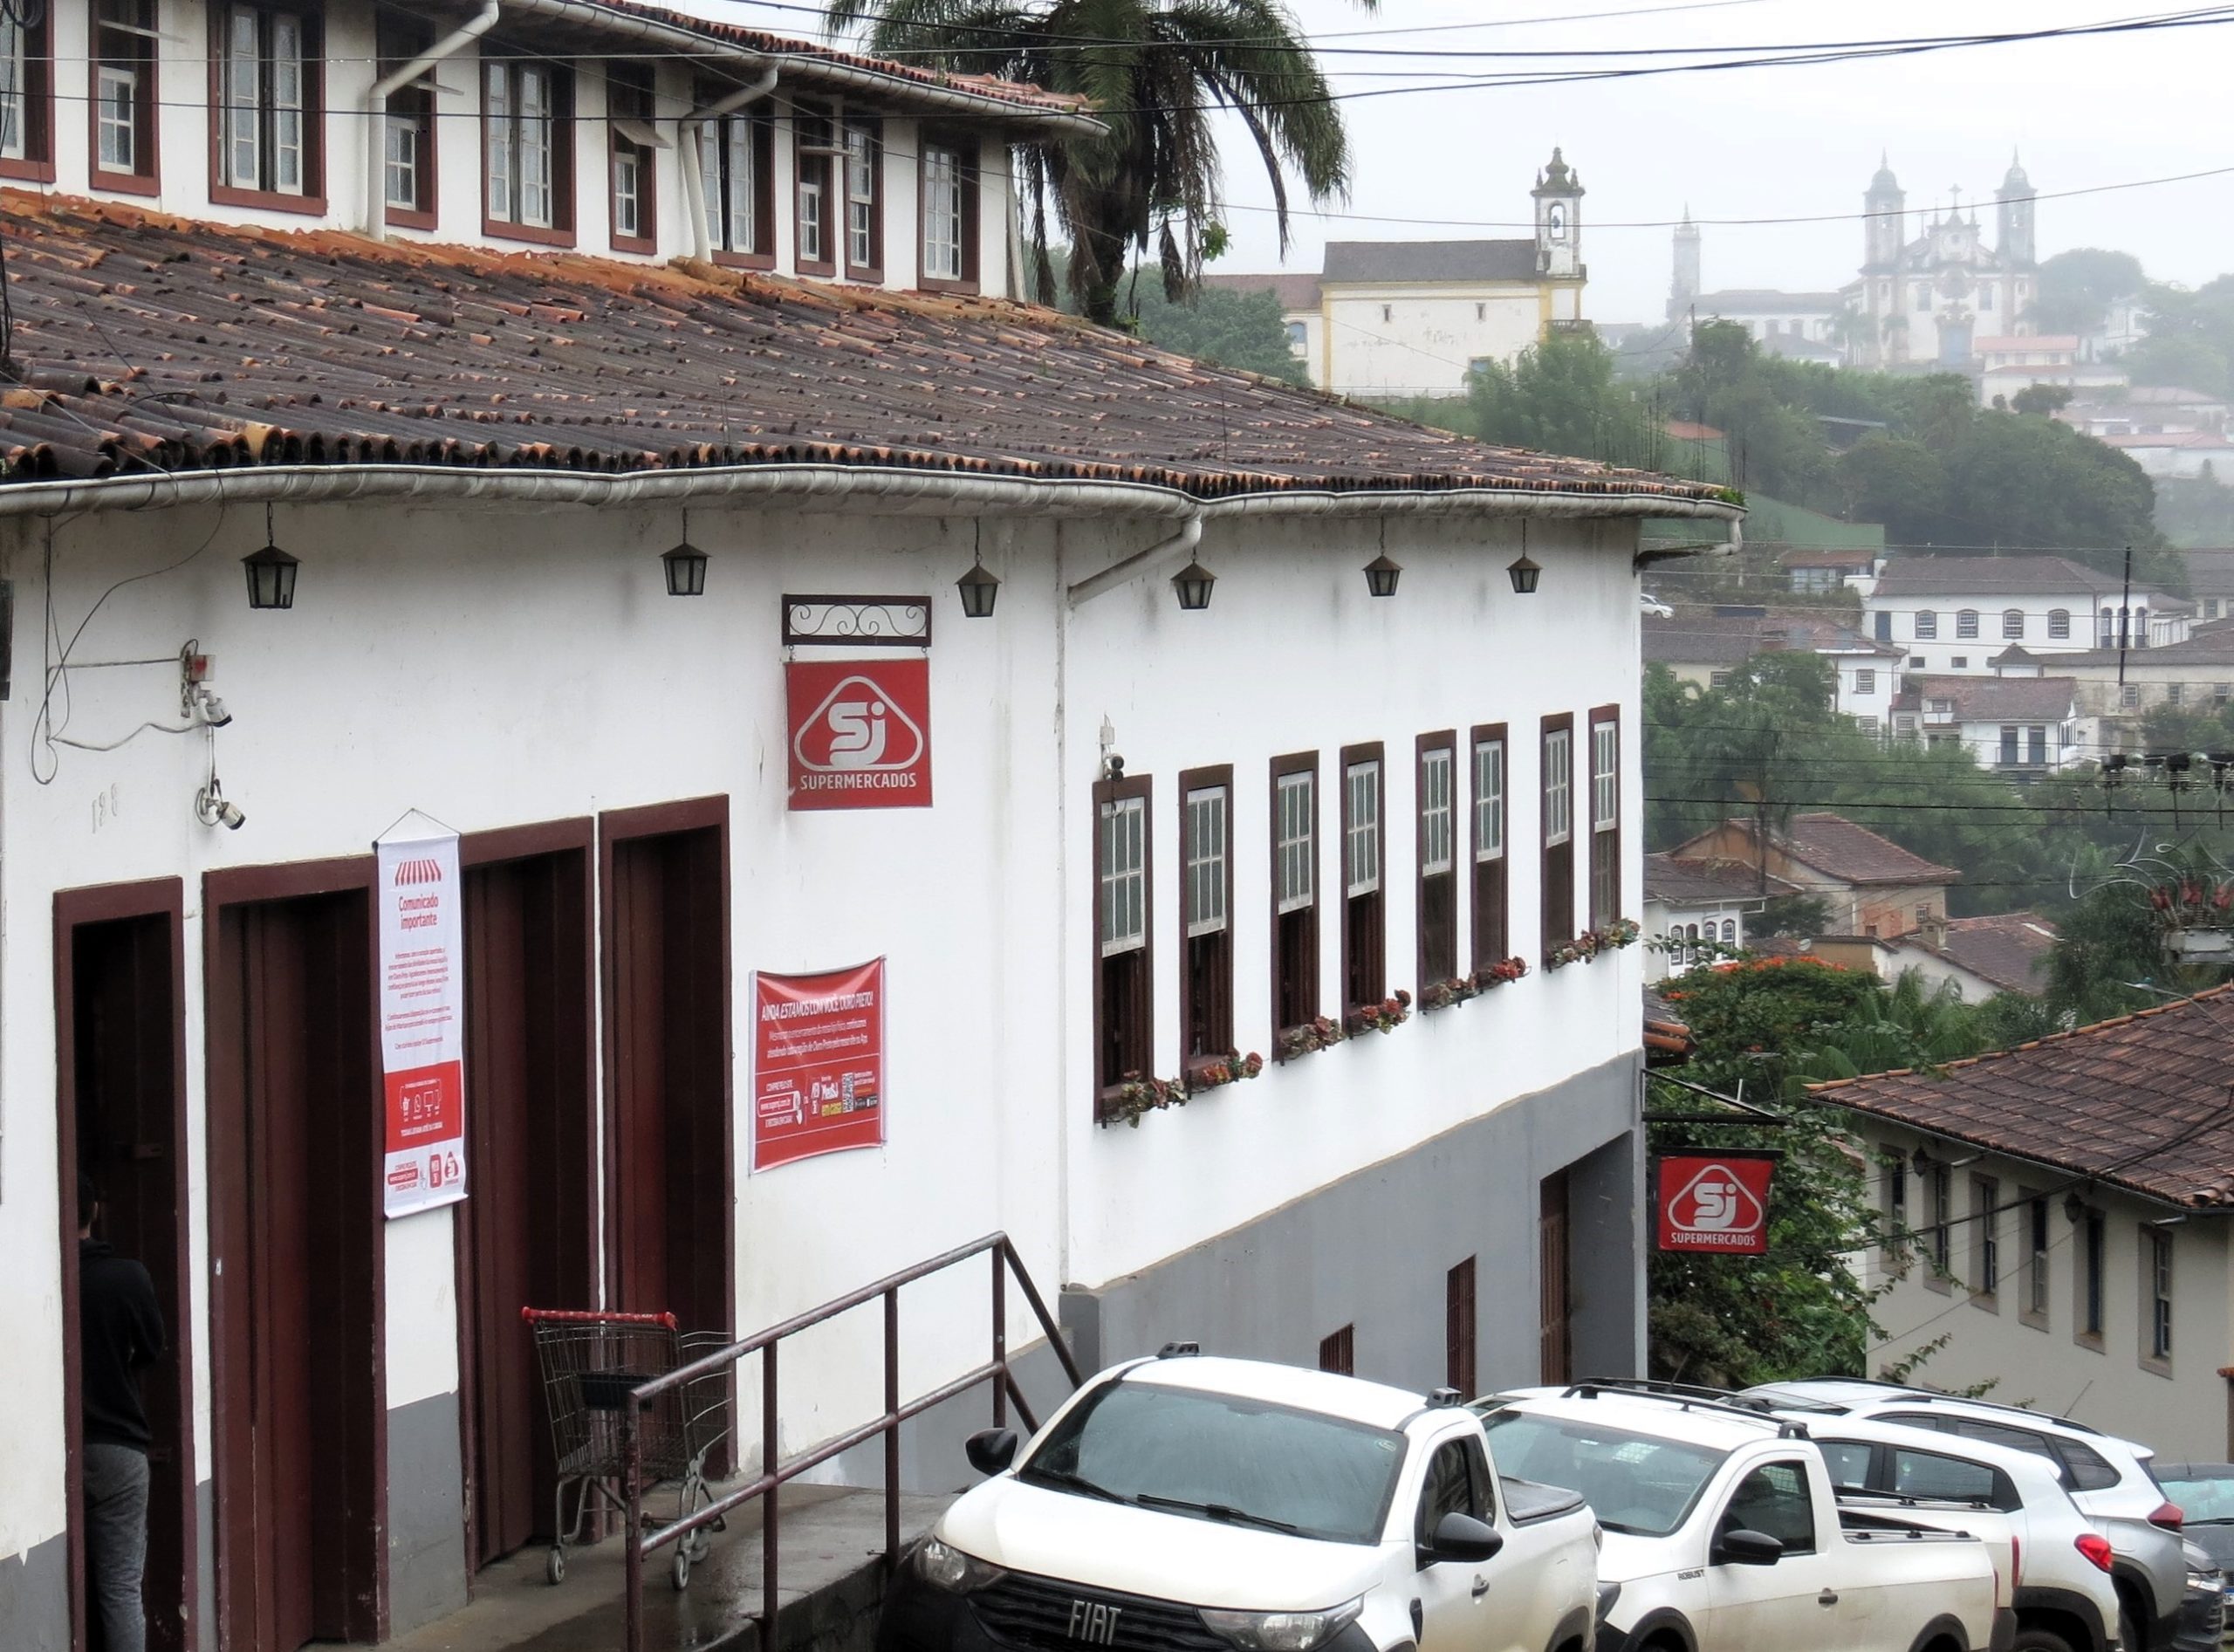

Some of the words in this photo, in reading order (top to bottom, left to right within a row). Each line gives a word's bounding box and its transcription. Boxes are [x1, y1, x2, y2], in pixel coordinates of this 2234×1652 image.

[800, 773, 917, 790] SUPERMERCADOS
[399, 892, 439, 912] Comunicado
[401, 913, 438, 933] importante
[1671, 1232, 1756, 1246] SUPERMERCADOS
[1068, 1600, 1122, 1646] FIAT
